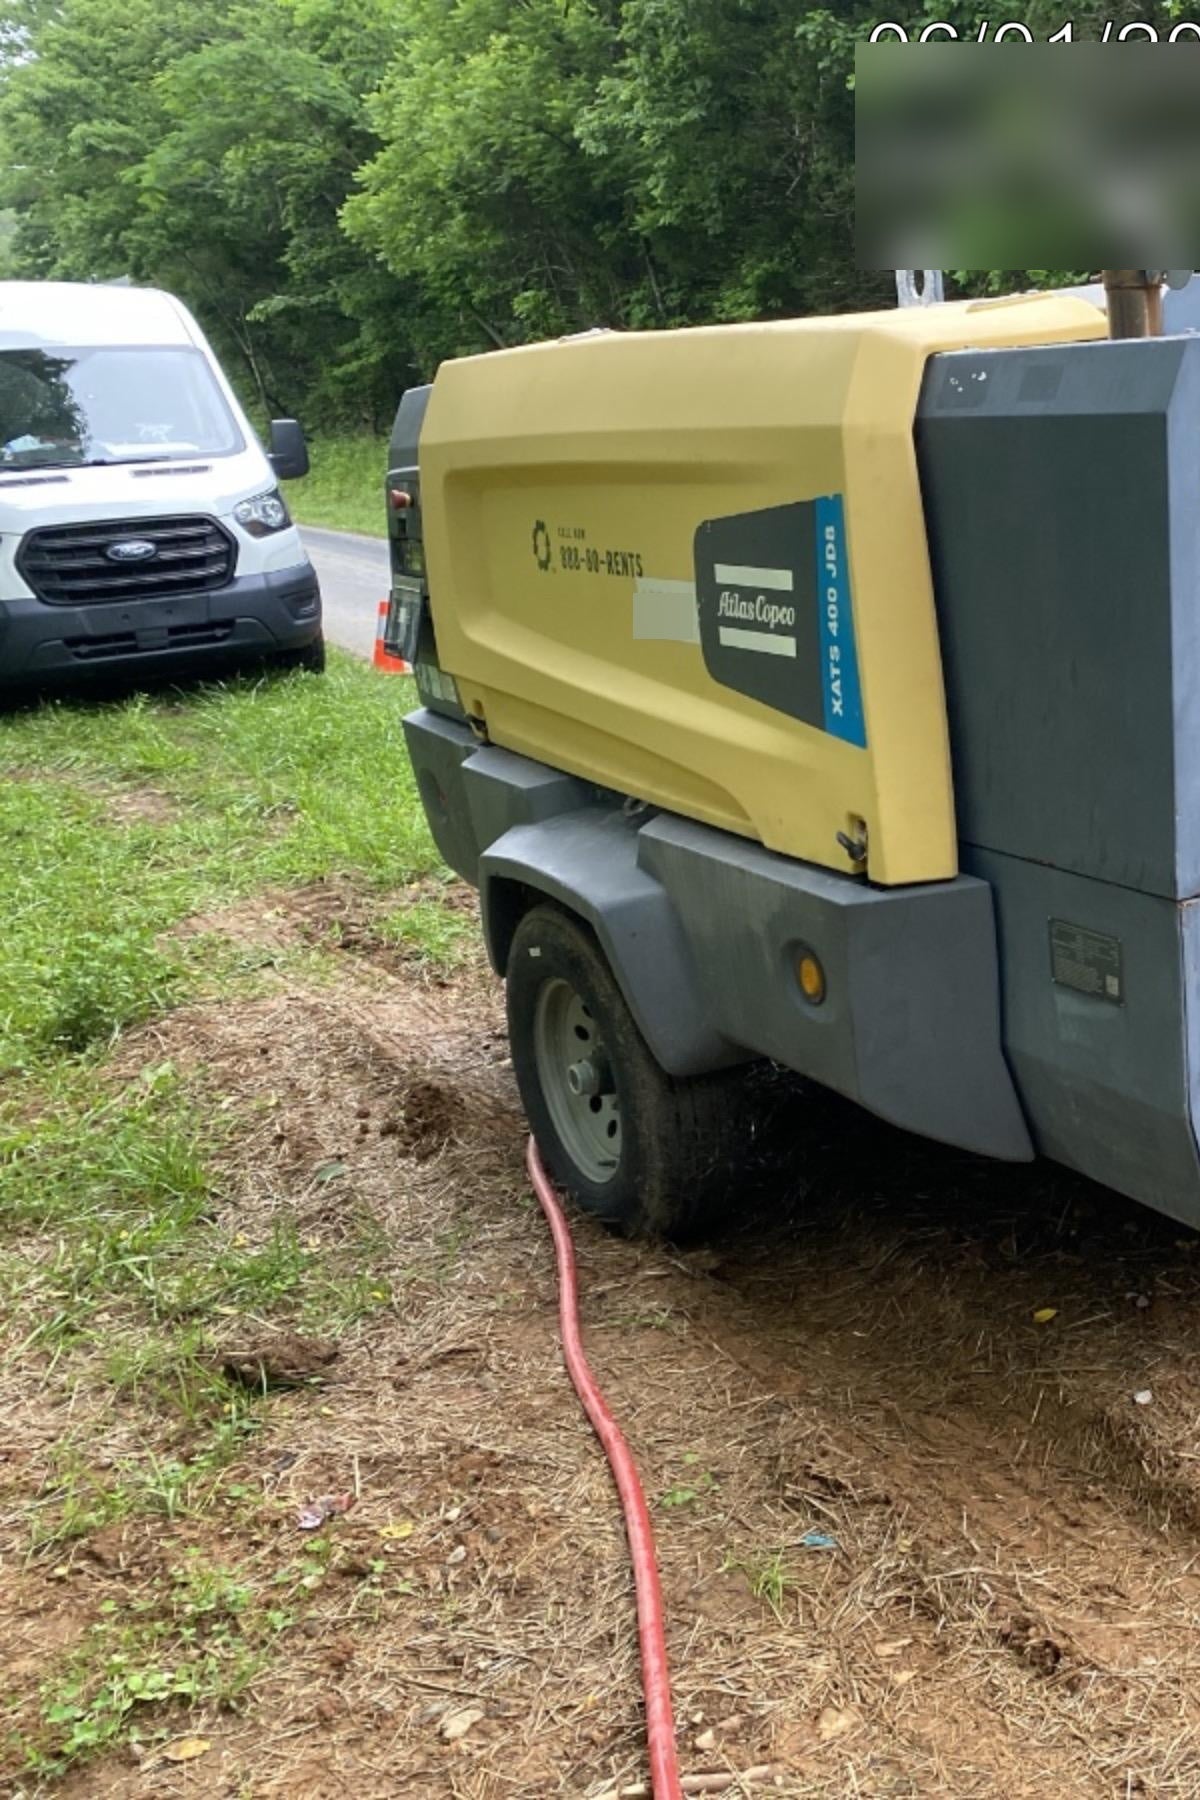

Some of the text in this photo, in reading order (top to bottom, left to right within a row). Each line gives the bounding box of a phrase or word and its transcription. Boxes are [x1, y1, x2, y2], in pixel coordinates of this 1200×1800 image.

[717, 591, 796, 630] Atlas Copco
[826, 587, 839, 637] 400
[828, 644, 844, 717] XATS
